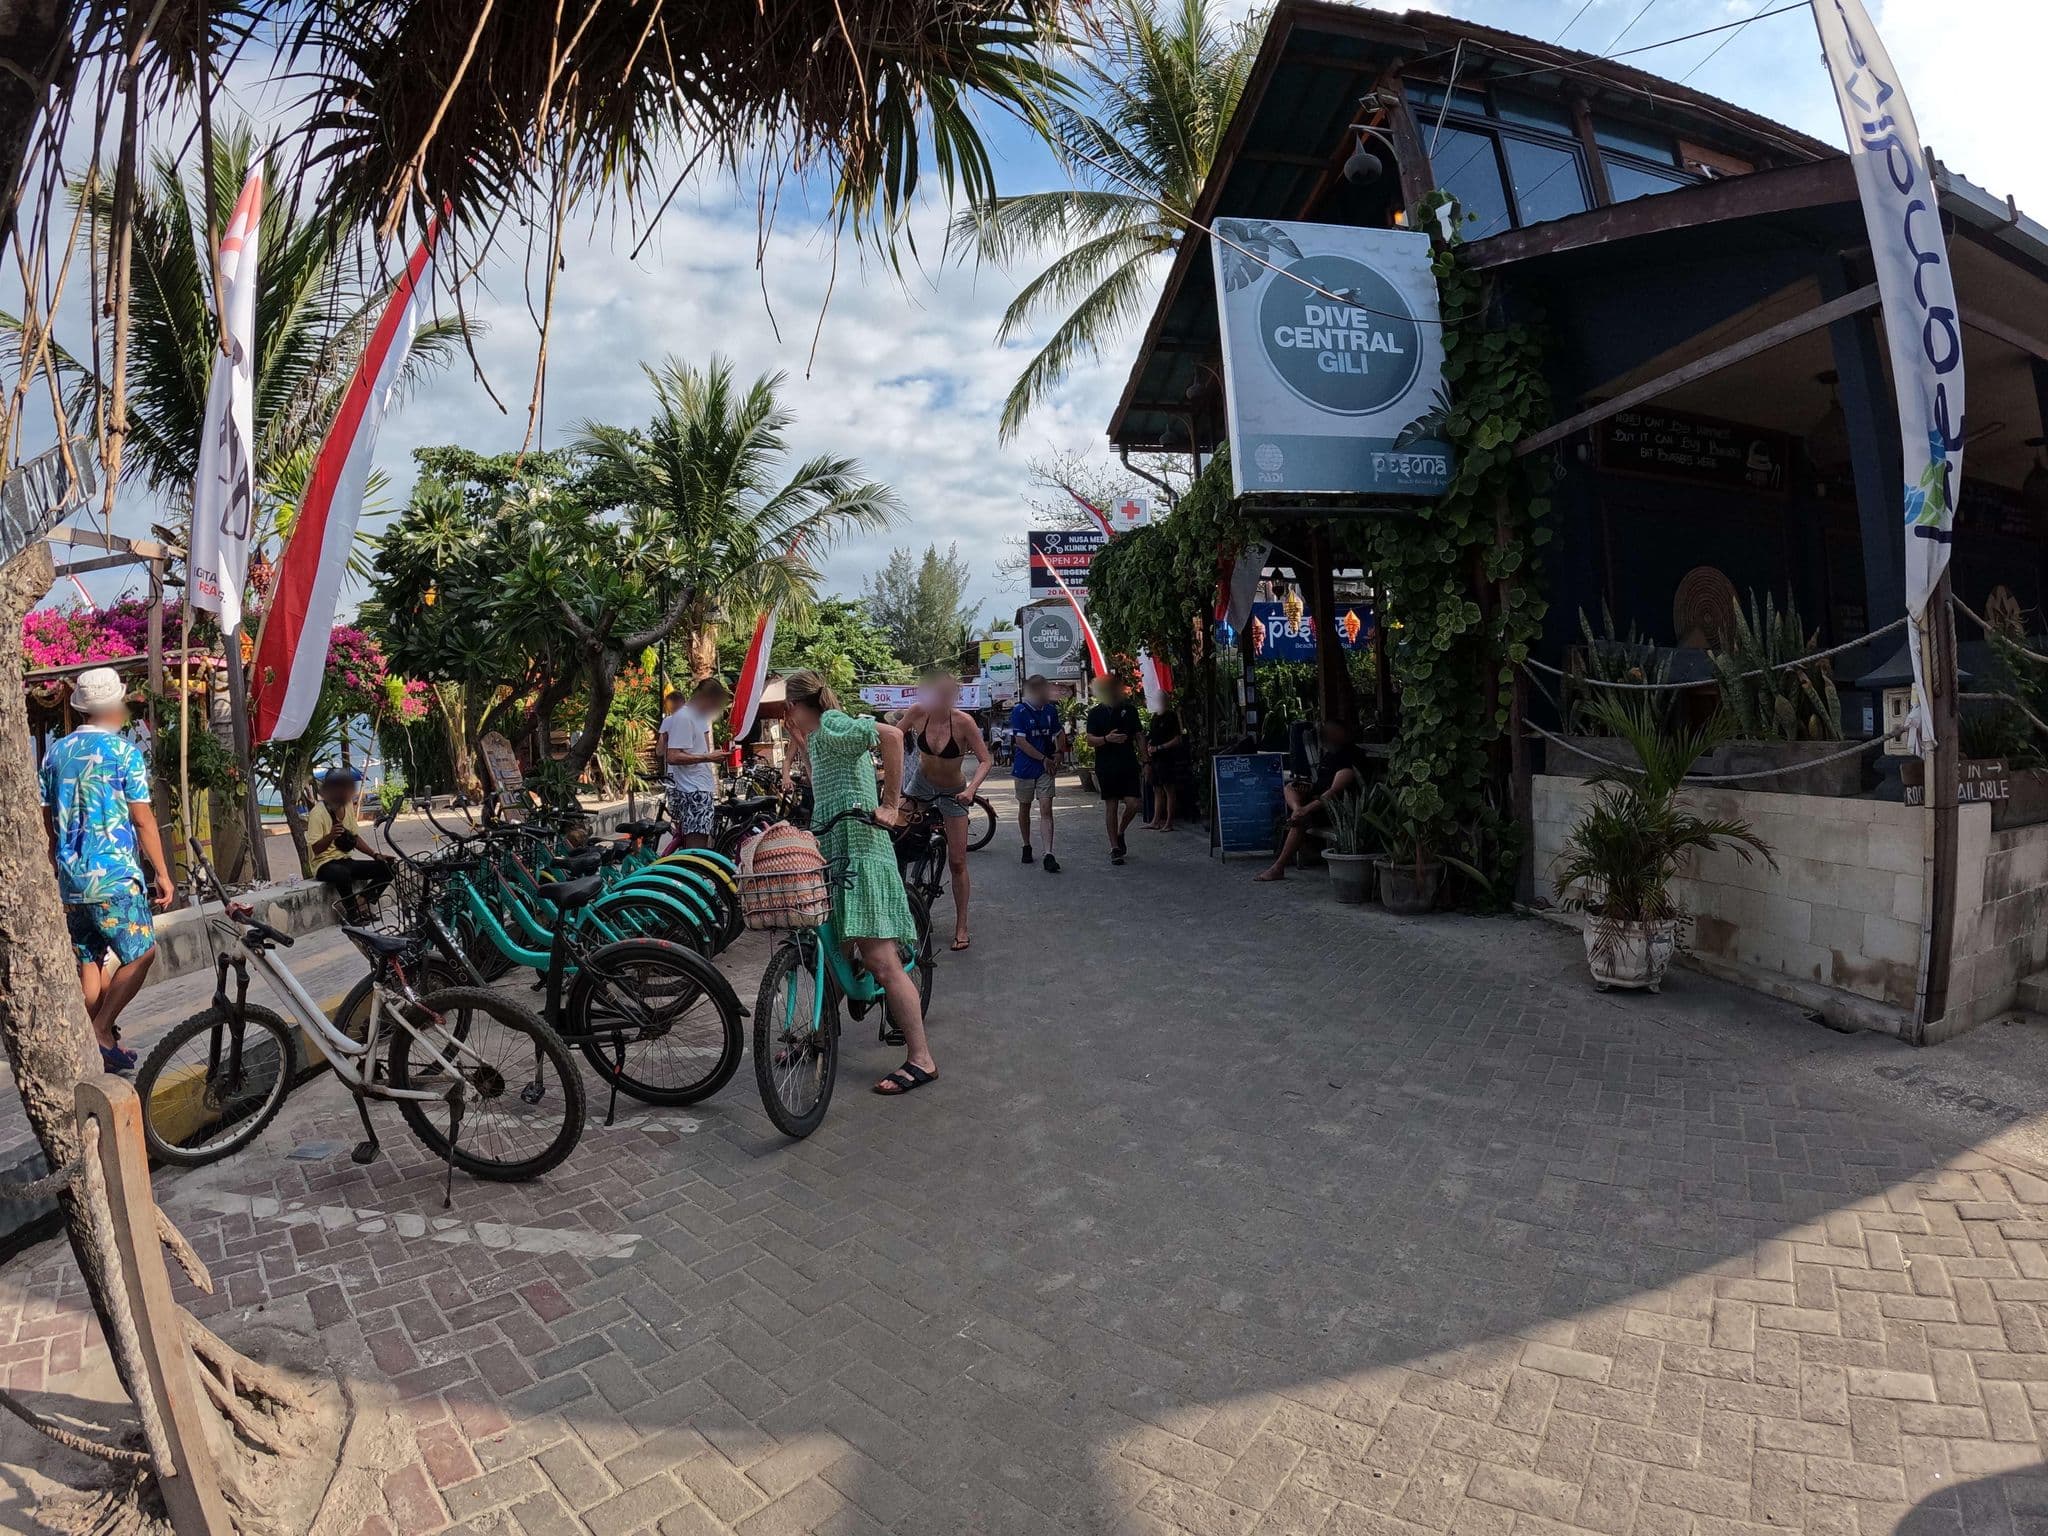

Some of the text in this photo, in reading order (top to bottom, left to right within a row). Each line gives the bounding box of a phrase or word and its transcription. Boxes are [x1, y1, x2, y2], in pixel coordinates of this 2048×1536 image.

[1304, 304, 1369, 329] DIVE
[1274, 325, 1404, 354] CENTRAL
[1317, 352, 1369, 375] GILI
[1072, 556, 1085, 565] 24
[1032, 635, 1069, 643] CENTRAL
[1968, 764, 1981, 778] IN
